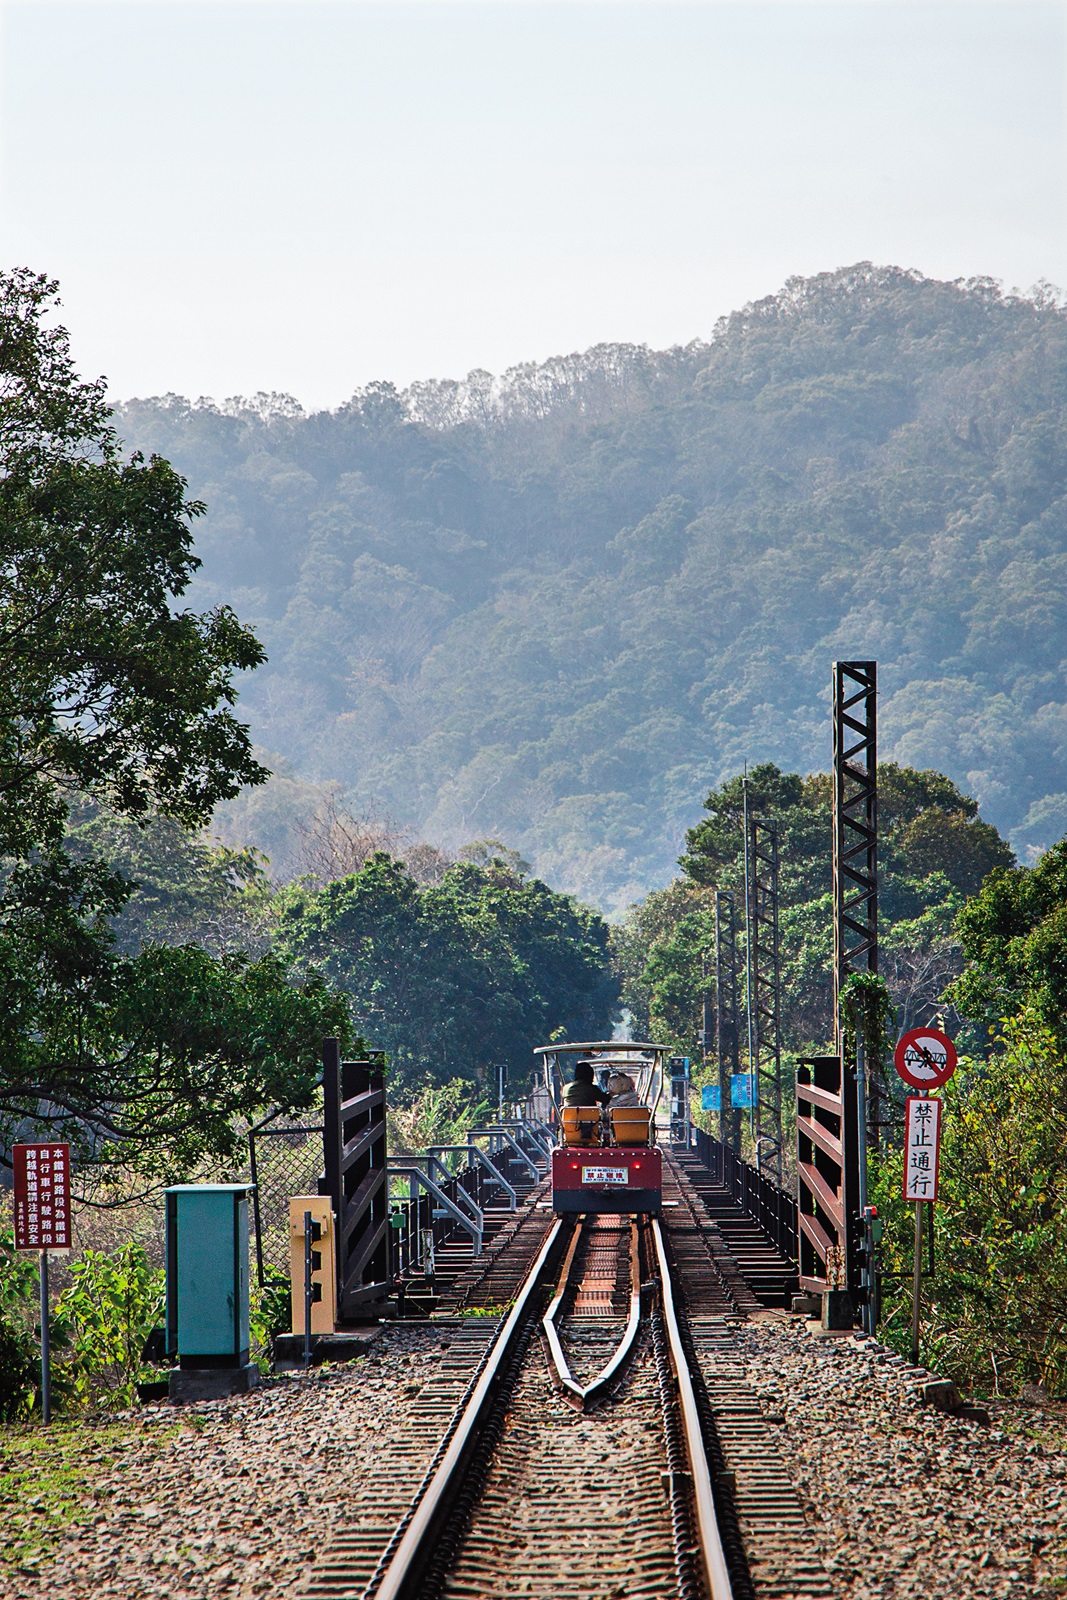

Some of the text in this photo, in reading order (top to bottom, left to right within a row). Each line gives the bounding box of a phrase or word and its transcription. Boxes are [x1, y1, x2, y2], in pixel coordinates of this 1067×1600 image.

[40, 1149, 52, 1244] 自行車行駛路段
[53, 1149, 66, 1244] 本鐵路路段為鐵道
[910, 1103, 933, 1196] 禁止通行
[26, 1150, 39, 1245] 跨越軌道請注意安全
